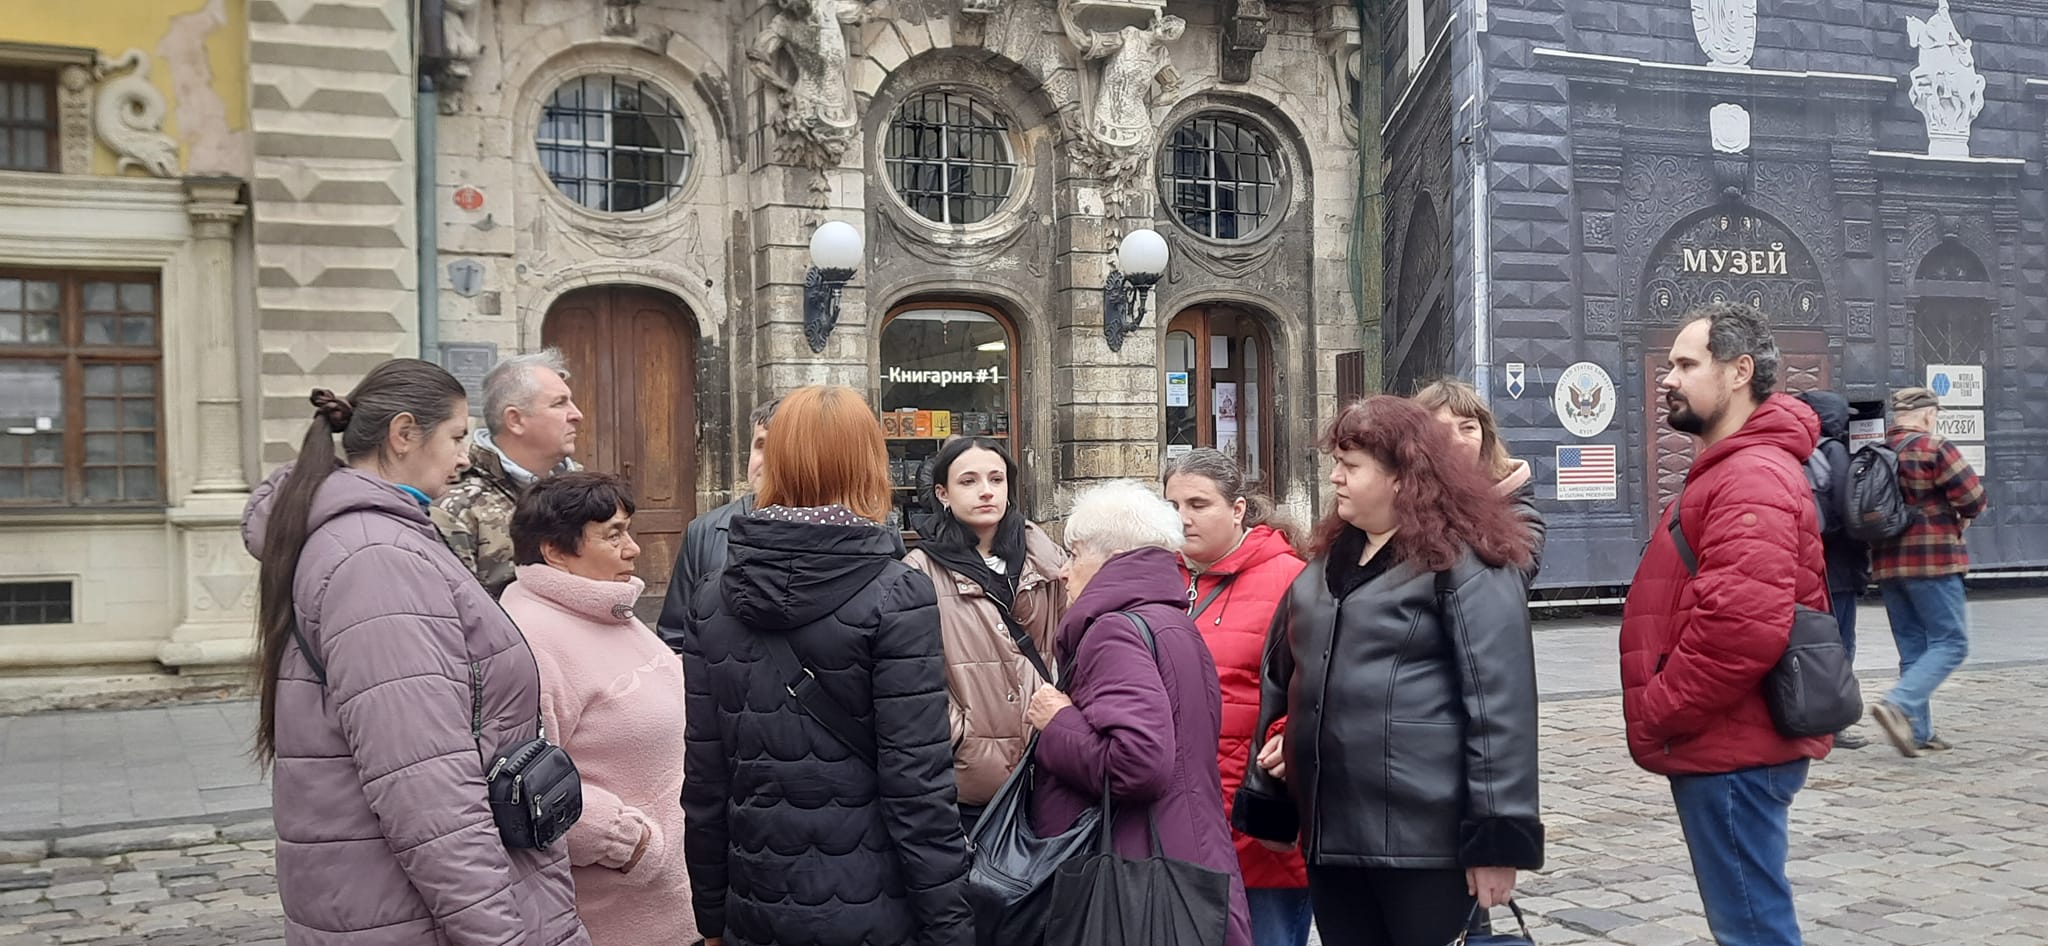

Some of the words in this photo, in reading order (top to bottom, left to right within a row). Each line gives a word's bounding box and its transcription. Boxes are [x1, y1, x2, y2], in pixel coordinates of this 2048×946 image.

[1683, 242, 1788, 275] МУЗЕЙ
[889, 366, 973, 387] Книгарня
[976, 365, 999, 384] #1
